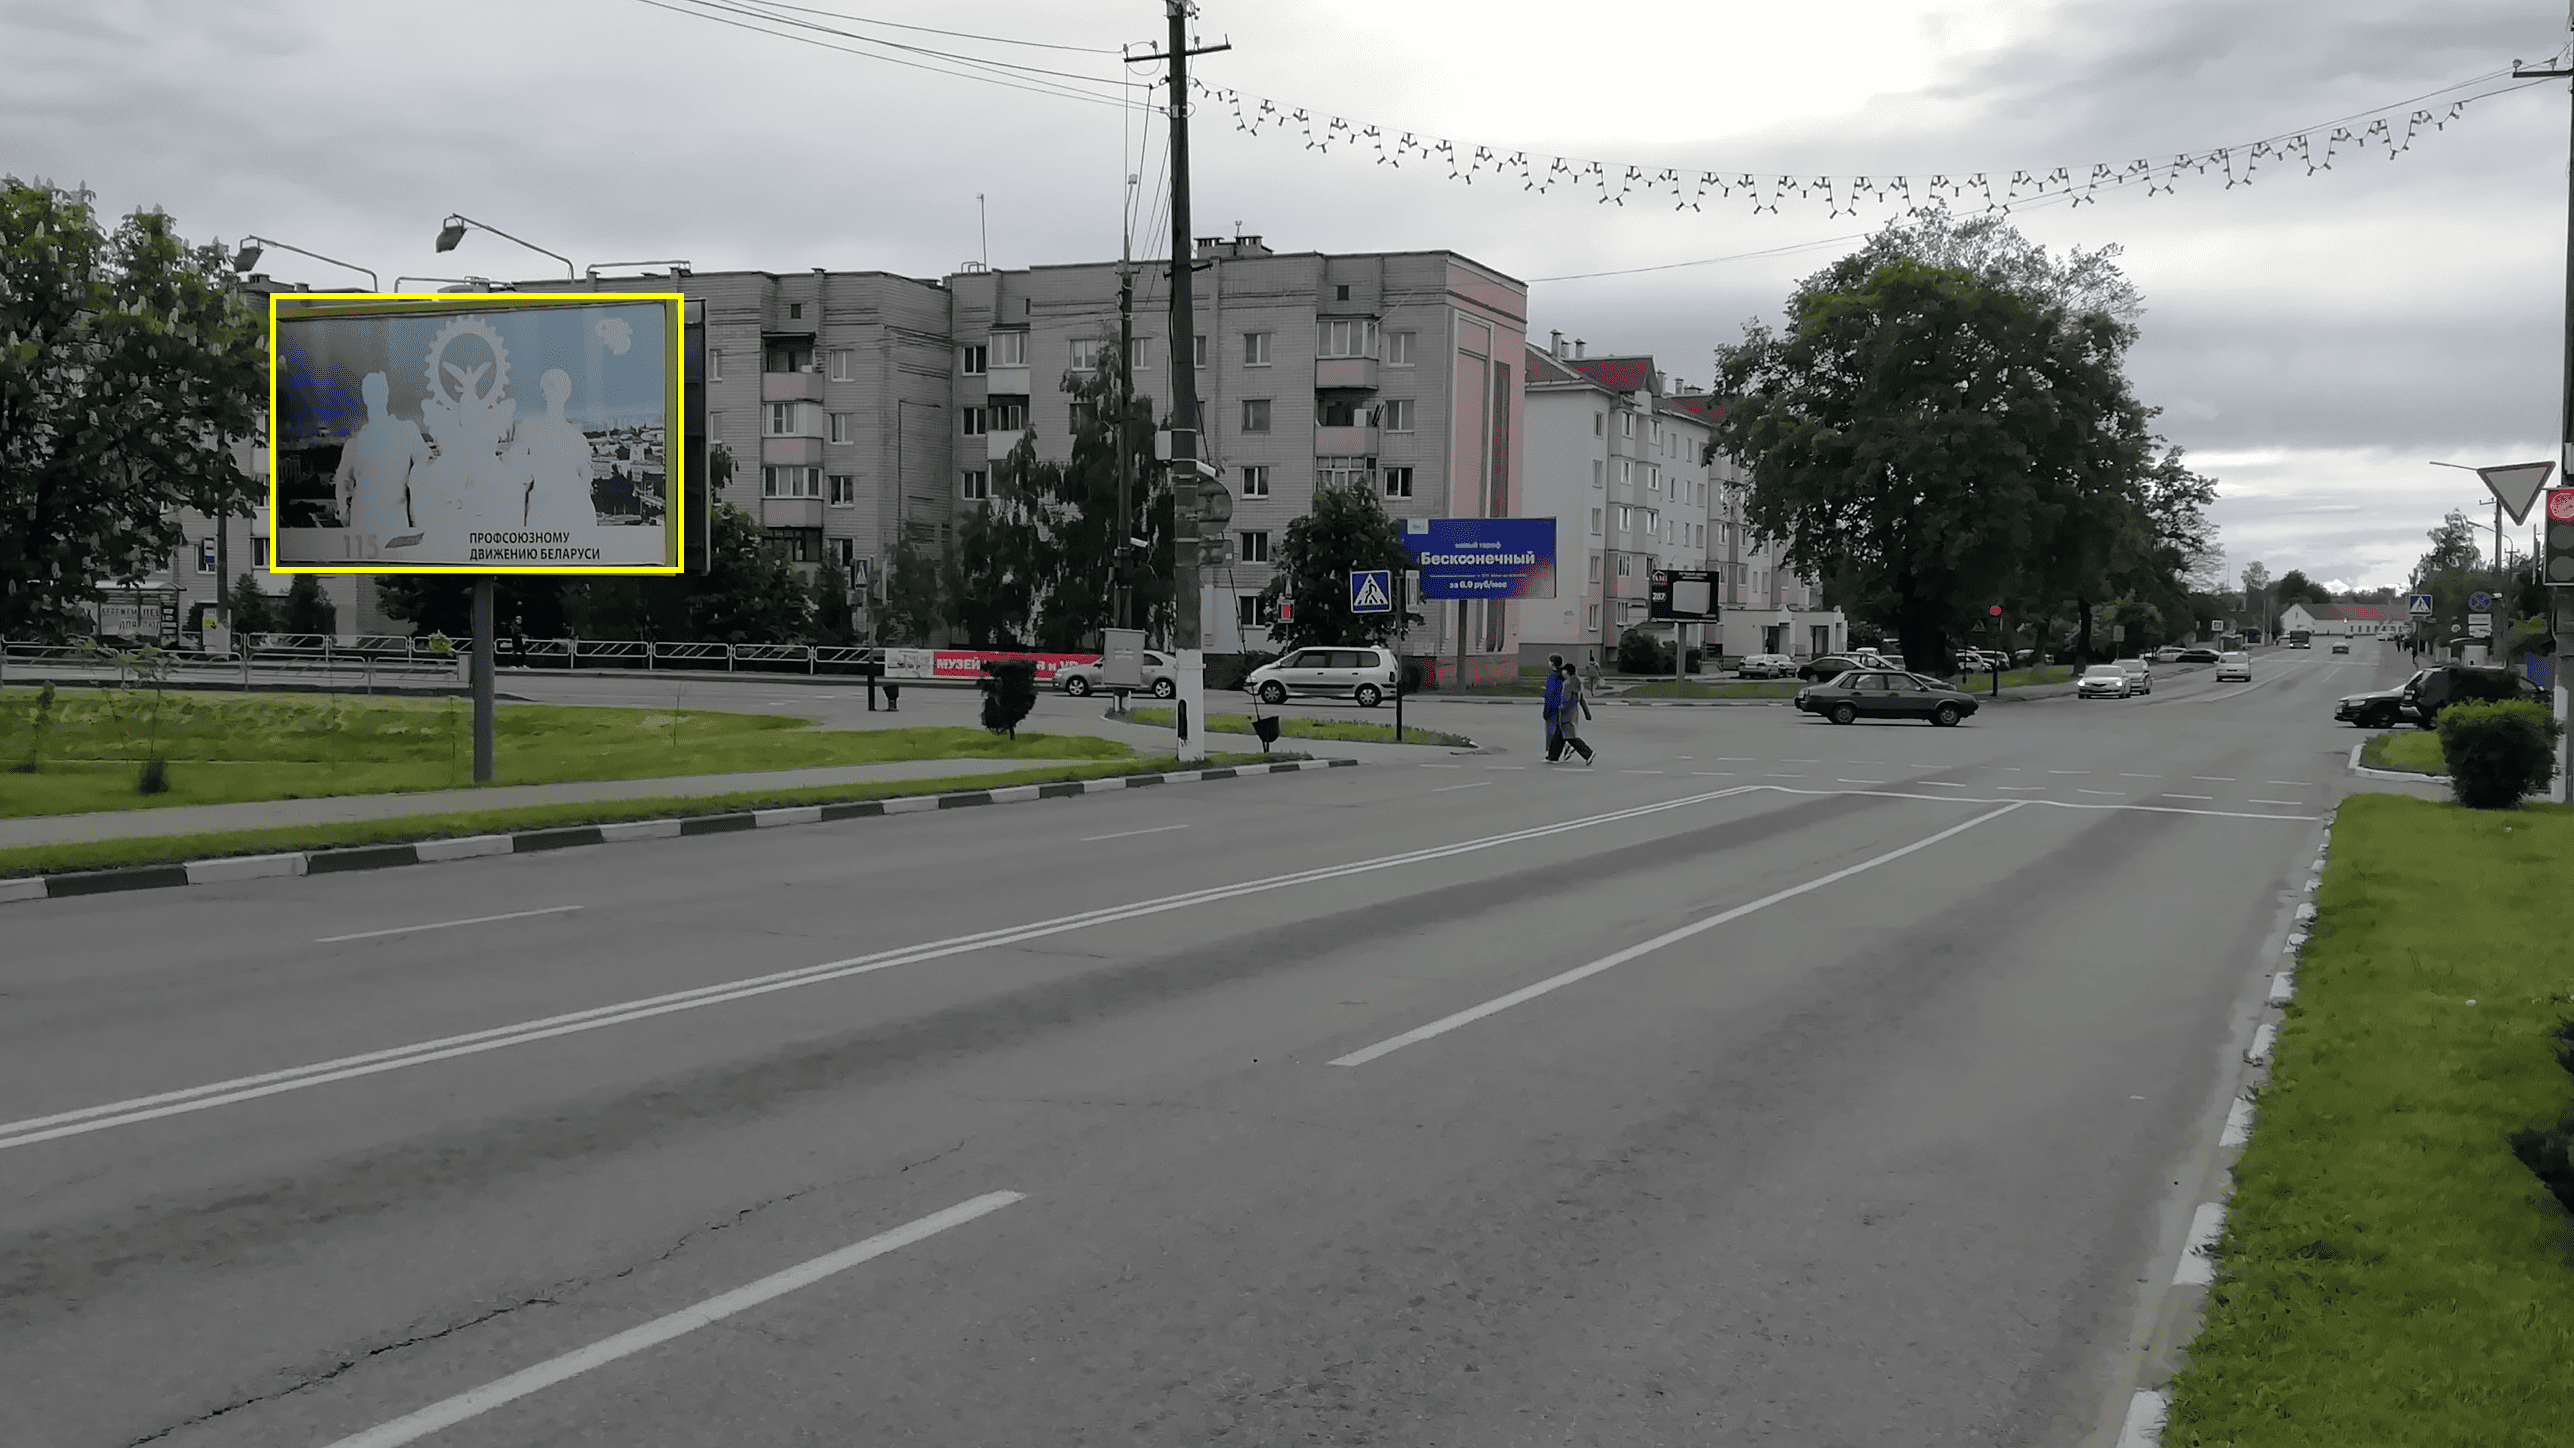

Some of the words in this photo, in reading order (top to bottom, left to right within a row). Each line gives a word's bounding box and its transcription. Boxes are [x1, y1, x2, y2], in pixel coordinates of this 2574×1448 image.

[469, 532, 570, 544] ПРОФСОЮЗНОМУ
[469, 548, 538, 561] ДВИЖЕНИЮ
[540, 548, 600, 560] БЕЛАРУСИ
[1420, 551, 1535, 565] Бесконечный
[936, 656, 981, 670] МУЗЕЙ
